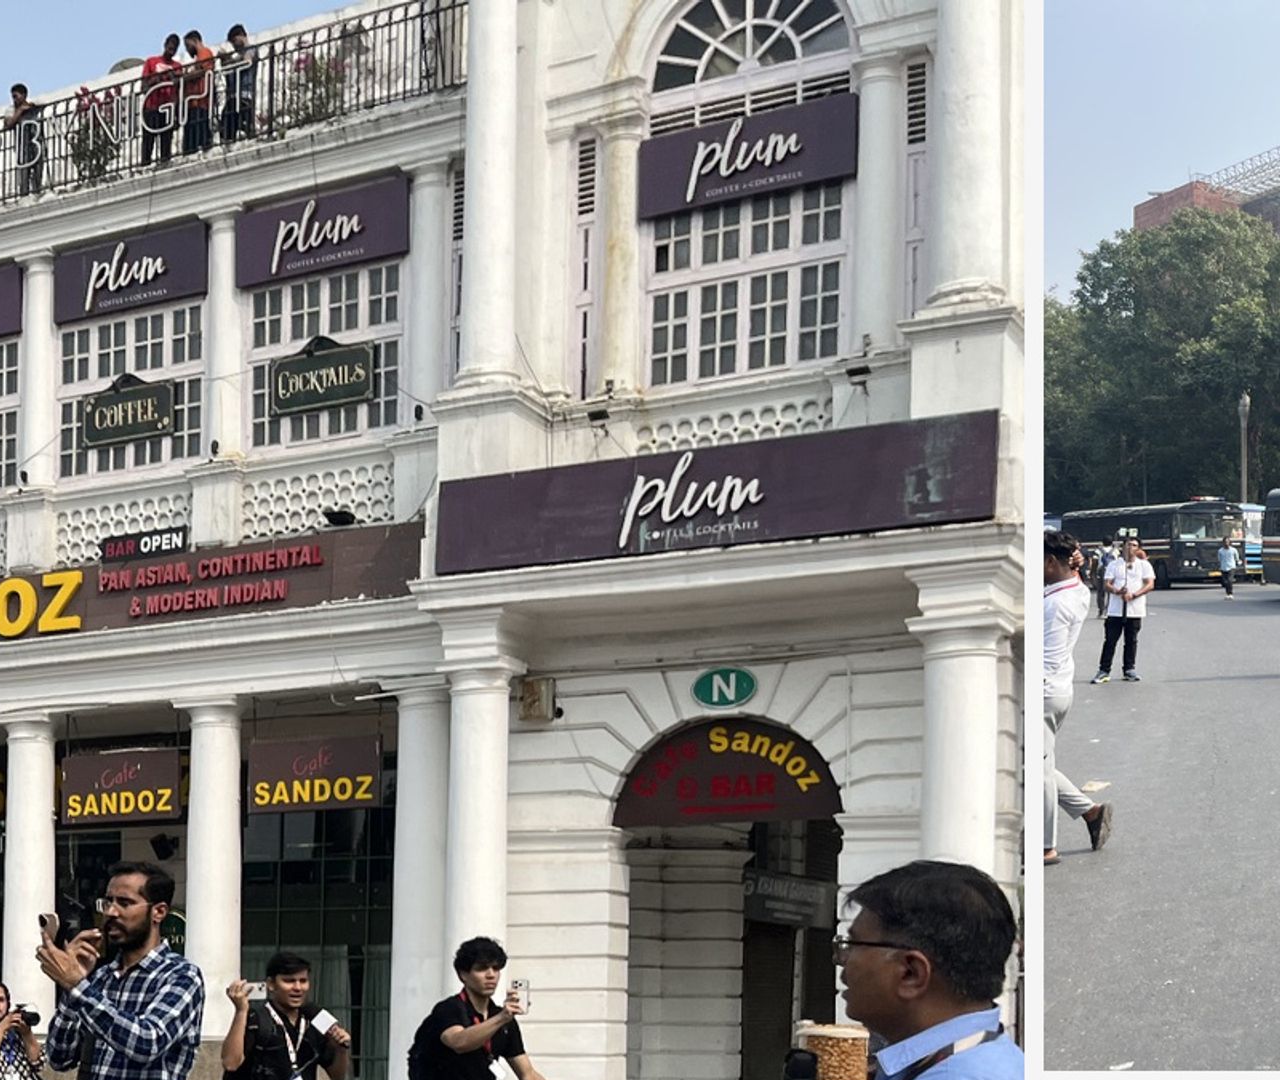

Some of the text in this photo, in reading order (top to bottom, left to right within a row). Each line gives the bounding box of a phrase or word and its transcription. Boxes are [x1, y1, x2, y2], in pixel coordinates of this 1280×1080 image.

[685, 118, 803, 202] plum
[271, 199, 363, 275] plum
[85, 241, 166, 312] plum
[277, 362, 367, 400] COCKTAILS
[93, 396, 159, 431] COFFEE
[618, 451, 765, 549] plum
[104, 531, 183, 558] BAR OPEN
[98, 545, 325, 593] PAN ASIAN, CONTINENTAL
[128, 579, 288, 618] & MODERN INDIAN
[711, 672, 737, 703] N
[707, 725, 822, 793] Sandoz
[66, 787, 174, 818] SANDOZ
[253, 774, 374, 806] SANDOZ
[709, 772, 778, 799] BAR
